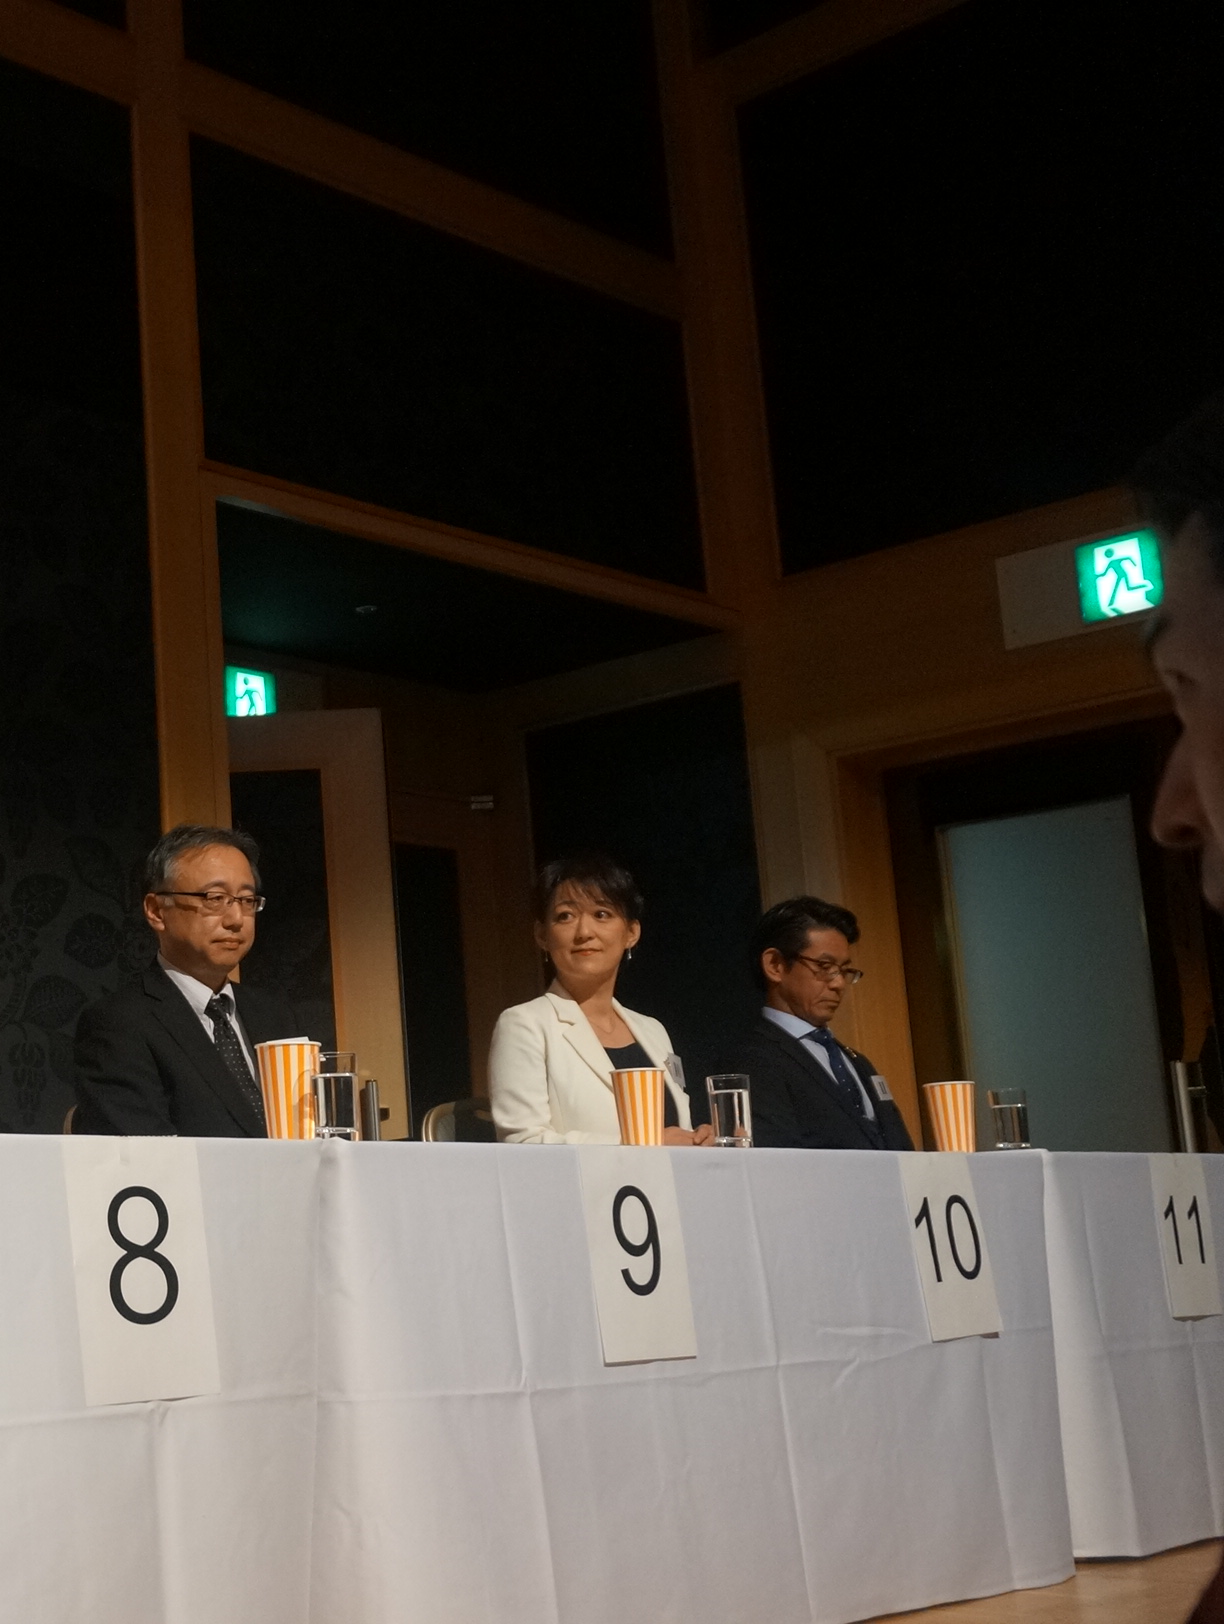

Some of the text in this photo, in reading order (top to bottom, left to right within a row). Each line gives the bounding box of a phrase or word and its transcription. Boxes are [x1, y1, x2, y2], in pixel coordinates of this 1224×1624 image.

[107, 1186, 179, 1325] 8
[612, 1185, 661, 1296] 9
[914, 1194, 982, 1283] 10
[1163, 1195, 1206, 1265] 11
